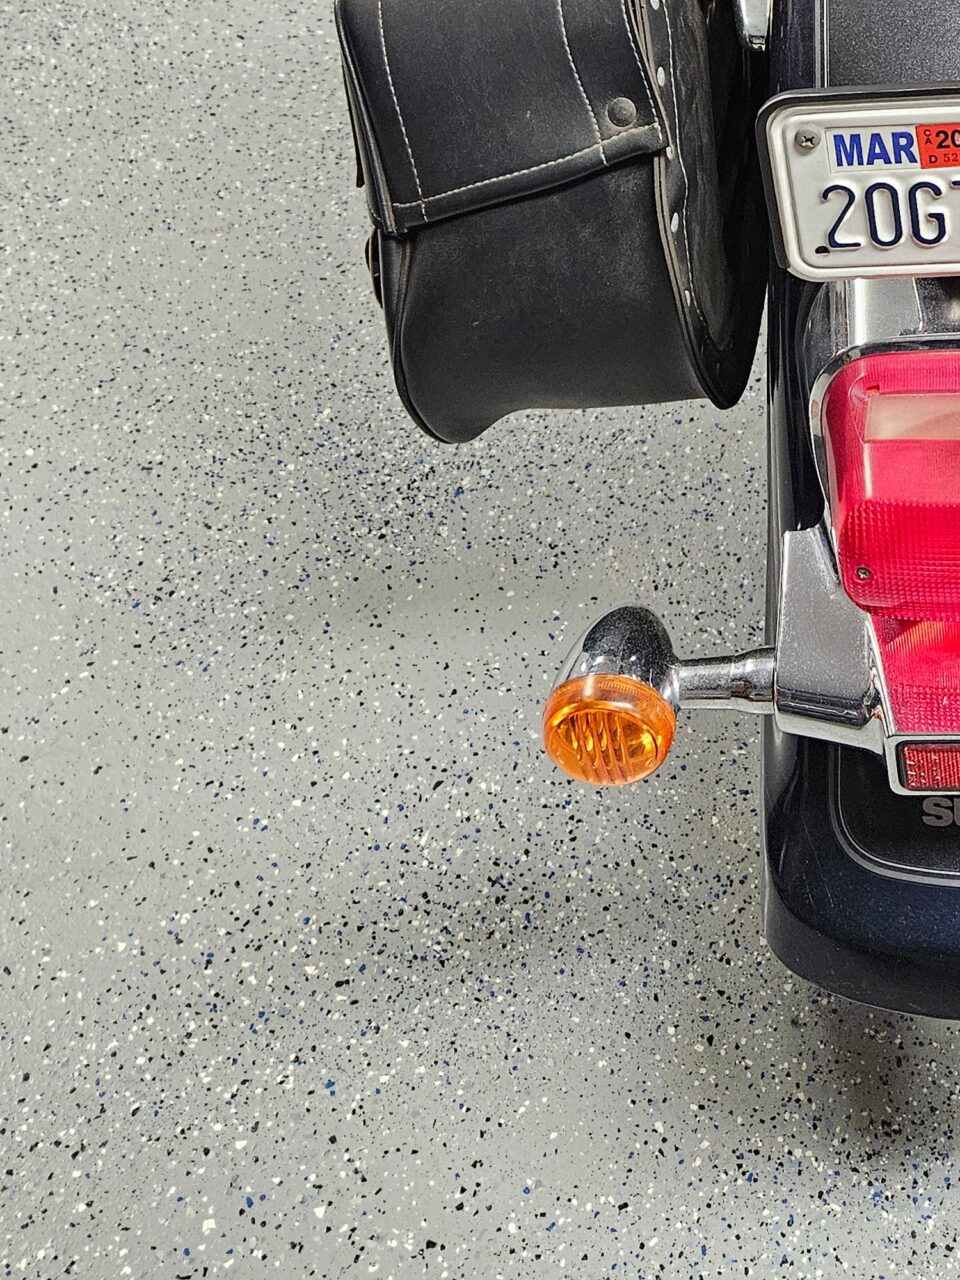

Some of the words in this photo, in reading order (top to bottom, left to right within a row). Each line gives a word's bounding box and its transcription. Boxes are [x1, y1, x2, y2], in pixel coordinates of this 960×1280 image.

[833, 131, 919, 167] MAR
[924, 129, 933, 145] CA
[928, 155, 938, 164] D
